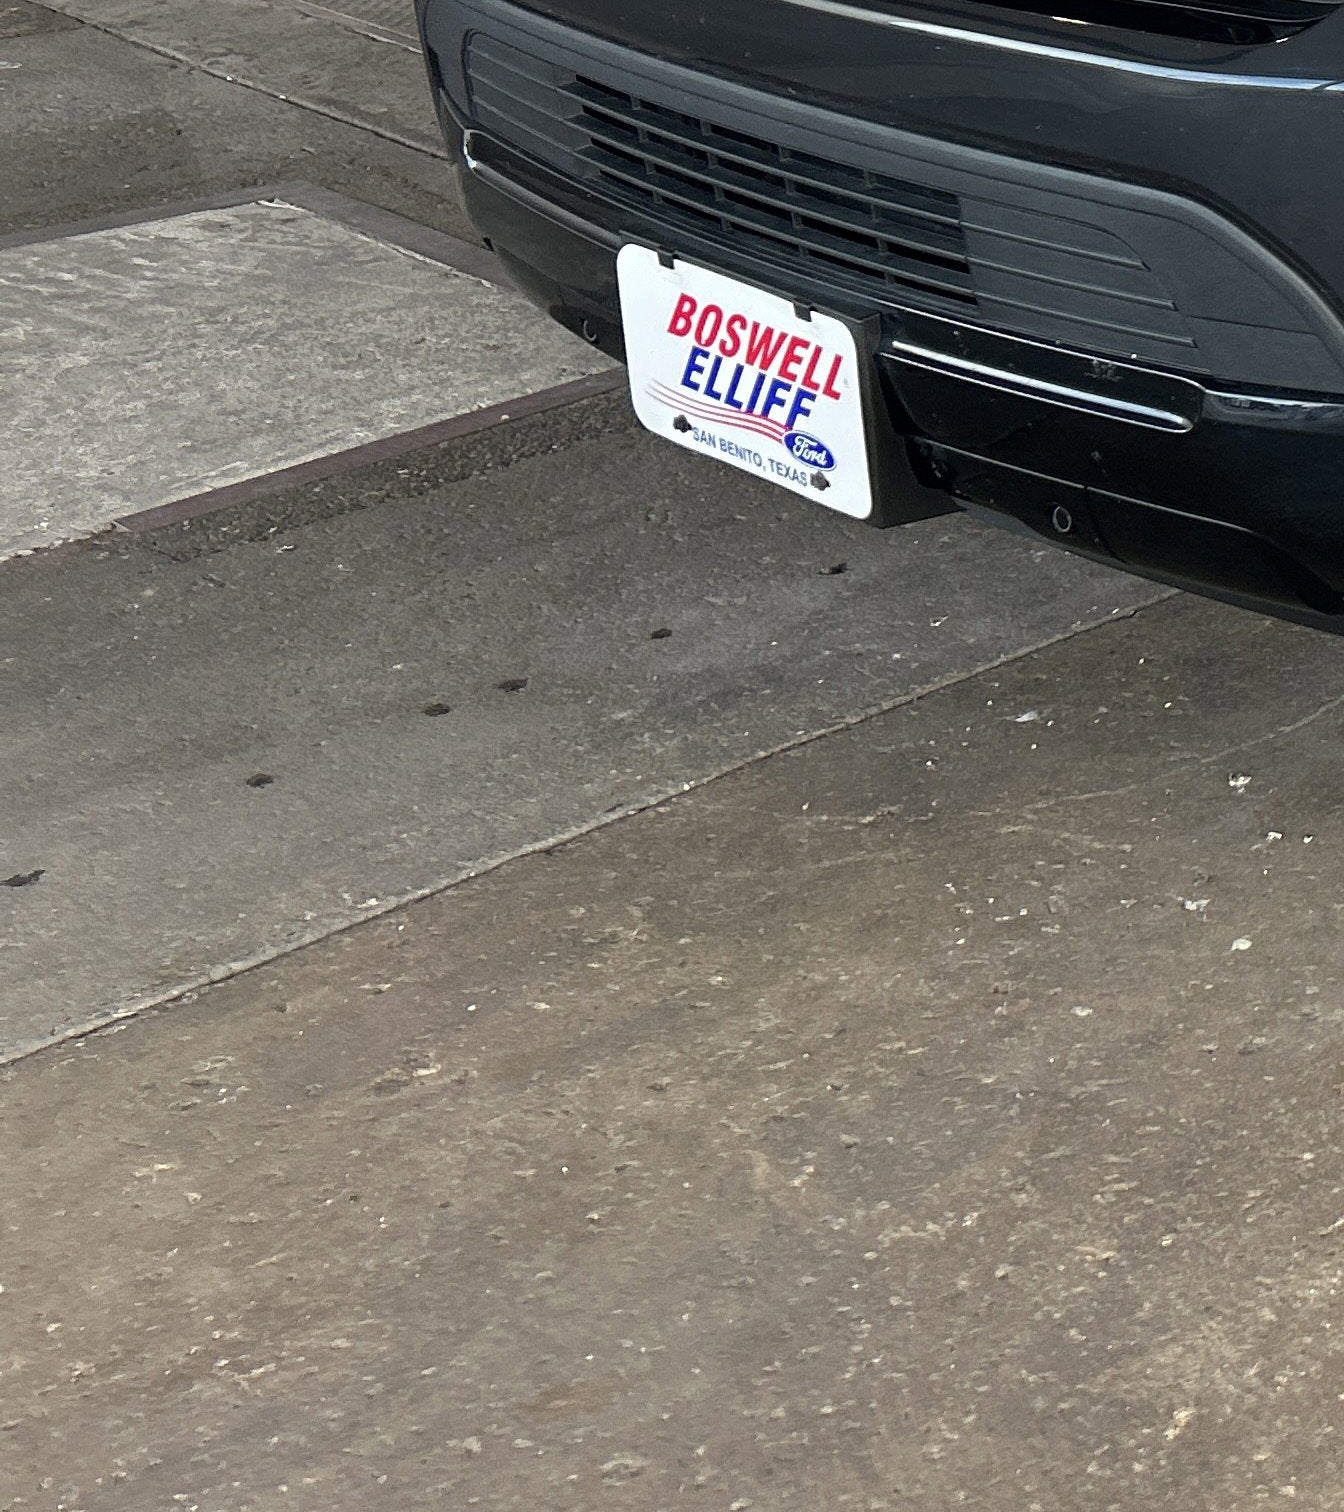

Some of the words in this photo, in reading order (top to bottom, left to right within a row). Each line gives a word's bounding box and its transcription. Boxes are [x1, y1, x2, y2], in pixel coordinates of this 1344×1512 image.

[667, 292, 843, 400] BOSWELL
[681, 346, 817, 430] ELLIFF
[692, 426, 716, 449] SAN
[768, 457, 808, 487] TEXAS
[792, 435, 828, 465] Ford
